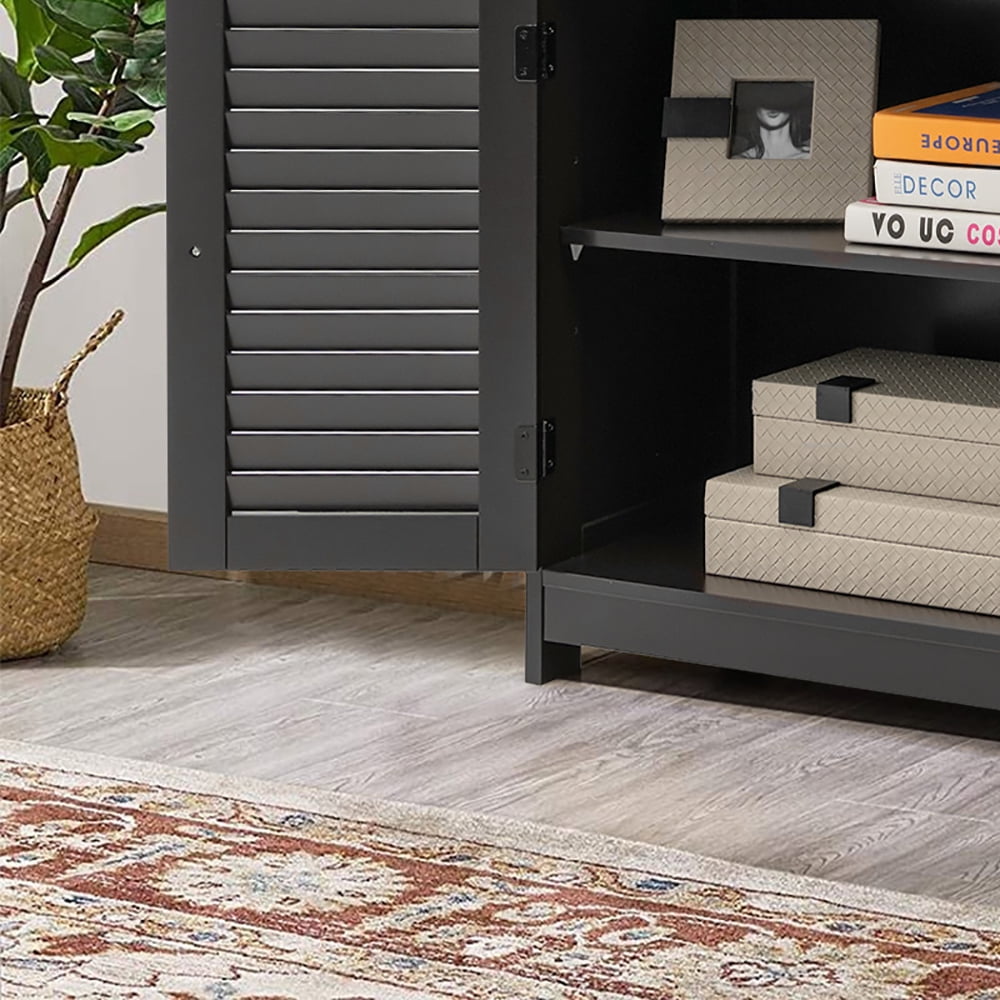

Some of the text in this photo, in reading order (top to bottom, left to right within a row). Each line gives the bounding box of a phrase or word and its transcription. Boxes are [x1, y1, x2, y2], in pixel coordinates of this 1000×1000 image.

[920, 133, 1000, 154] EUROPE
[902, 174, 977, 200] DECOR
[871, 211, 906, 239] VO
